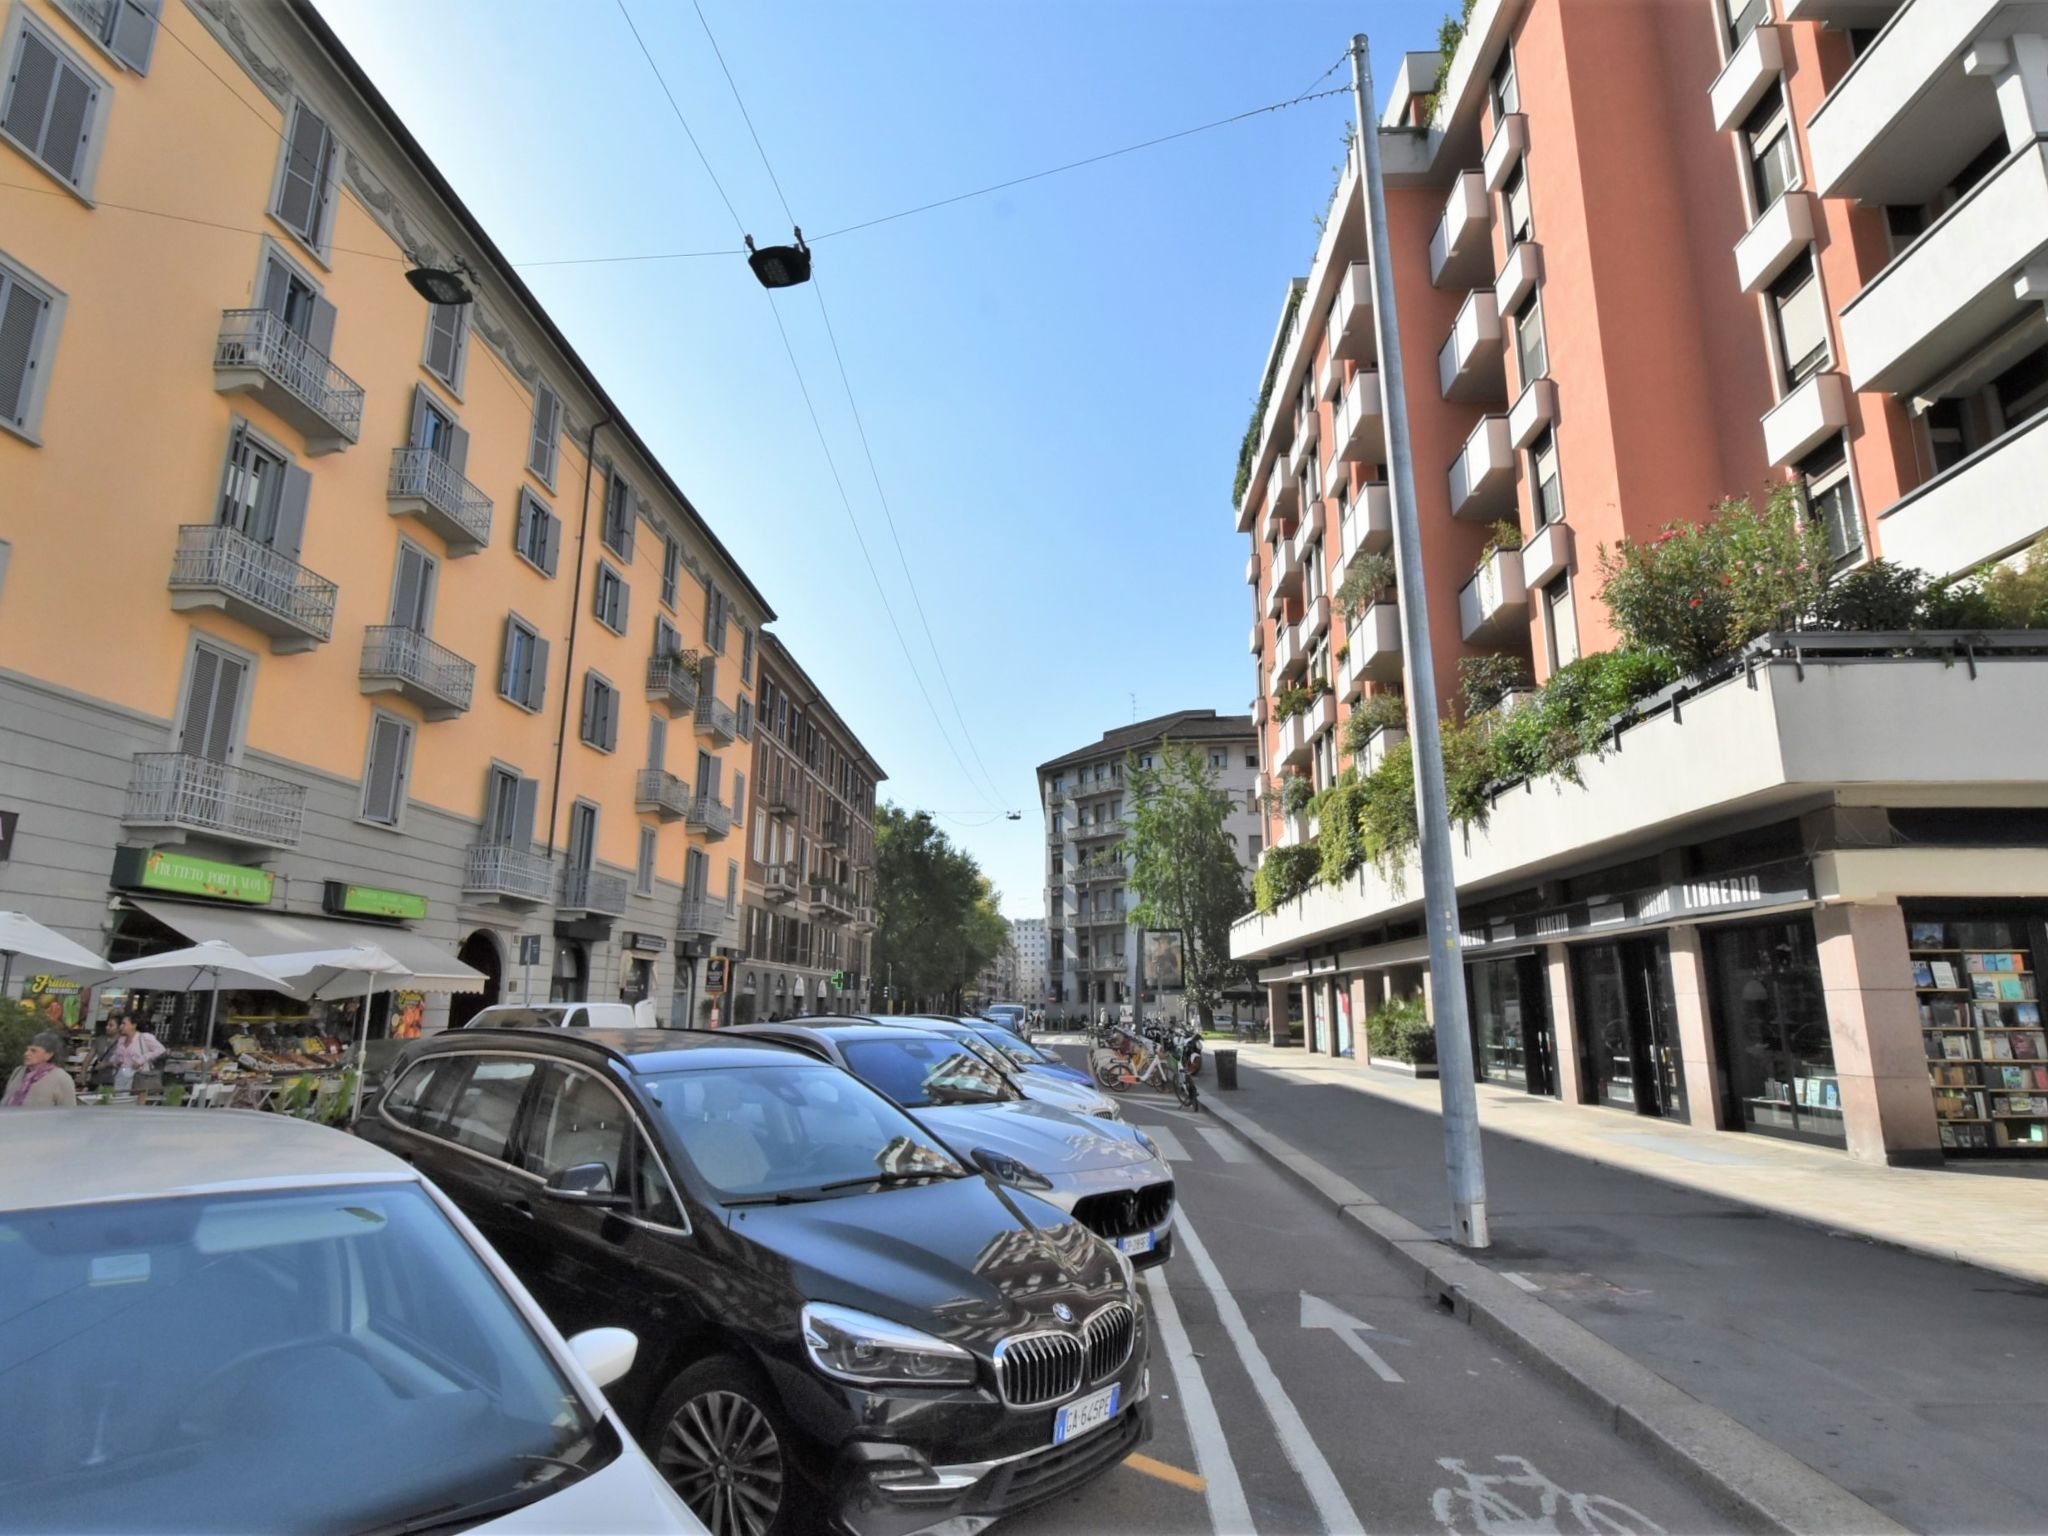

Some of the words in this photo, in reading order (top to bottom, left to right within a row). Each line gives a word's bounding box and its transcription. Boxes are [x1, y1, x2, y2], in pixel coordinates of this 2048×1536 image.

[153, 861, 204, 882] FRUTTETO
[207, 870, 237, 888] PORTA
[1638, 888, 1671, 920] LIBRERIA
[1682, 874, 1761, 909] LIBRERIA
[1536, 912, 1569, 937] LIBRERIA
